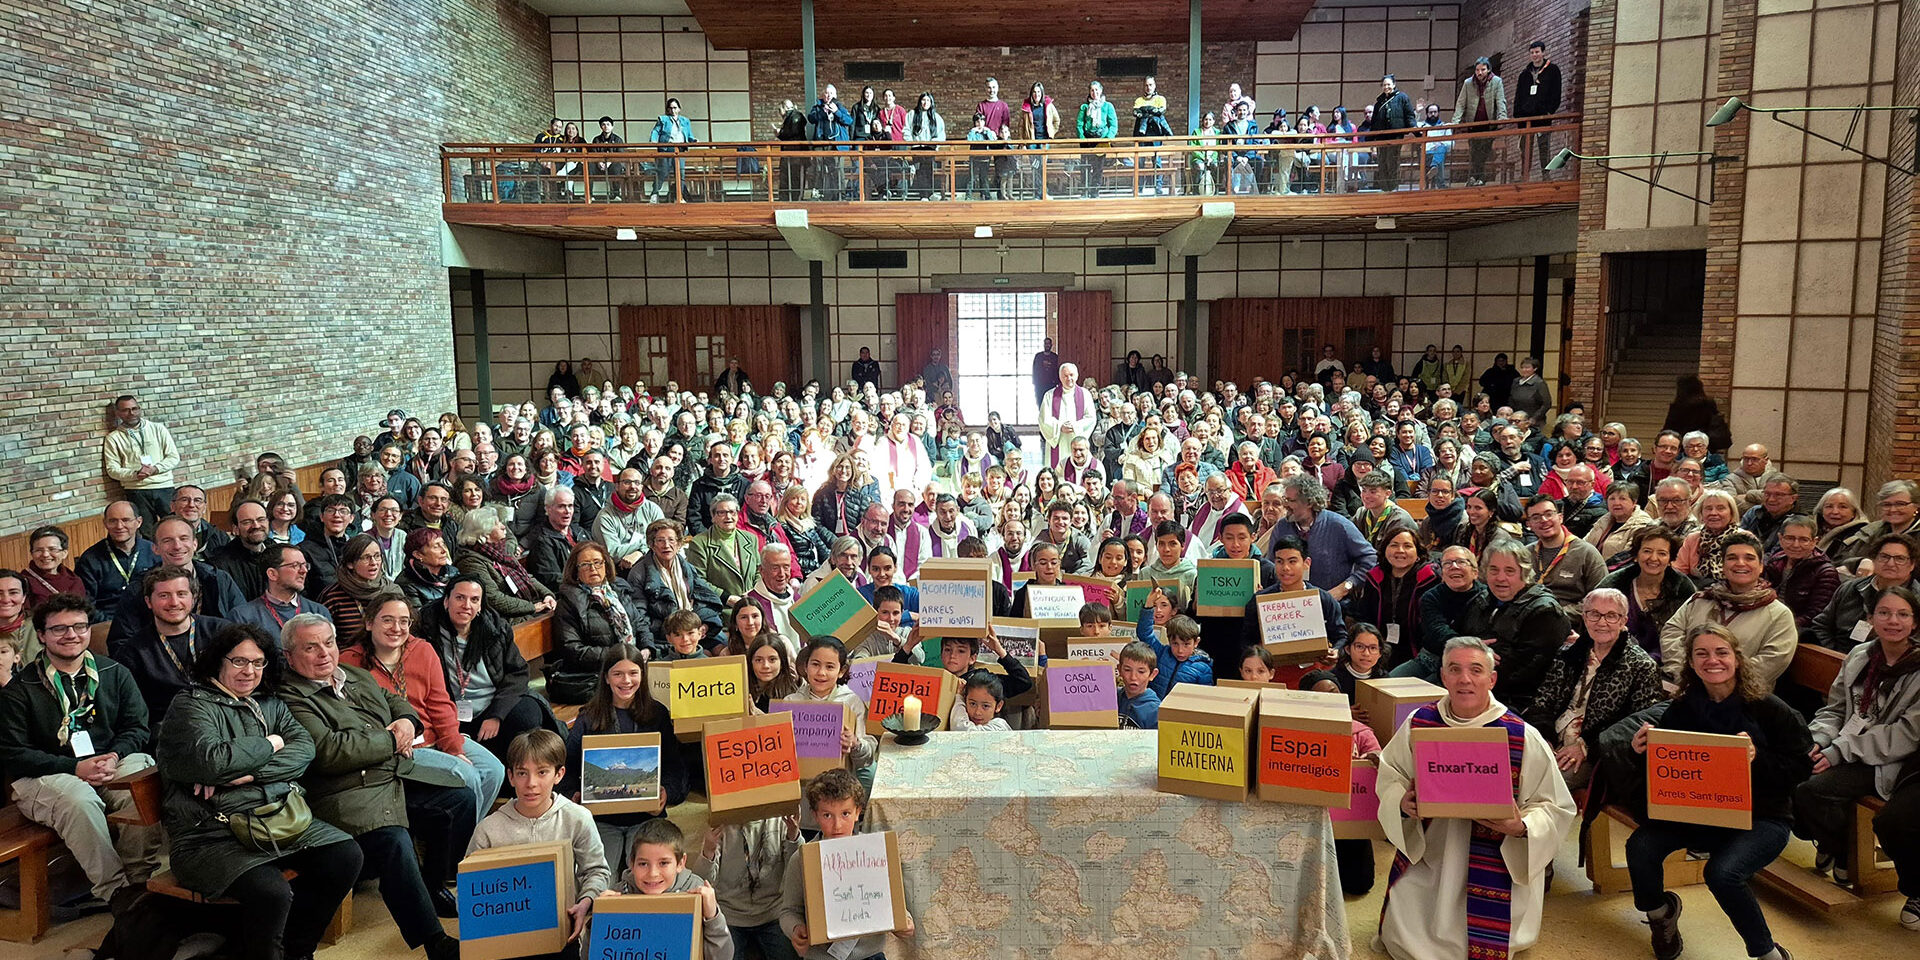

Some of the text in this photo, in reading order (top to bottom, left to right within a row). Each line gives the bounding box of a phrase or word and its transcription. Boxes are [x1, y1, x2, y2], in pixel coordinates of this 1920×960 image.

[1211, 576, 1241, 587] TSKV
[806, 588, 845, 621] Cristianisme
[922, 606, 954, 614] ARRELS
[1262, 598, 1313, 612] TREBALL DE
[921, 615, 974, 626] SANT IGNASI
[1265, 610, 1304, 623] CARRER
[1111, 628, 1135, 639] CENTR
[1266, 623, 1297, 632] ARRELS
[1267, 629, 1314, 641] SANT IGNASI
[1070, 649, 1104, 657] ARRELS
[849, 669, 876, 680] Eco-m
[1064, 673, 1096, 682] CASAL
[653, 681, 671, 689] Hos
[678, 680, 736, 699] Marta
[878, 676, 931, 697] Esplai
[1064, 684, 1100, 694] LOIOLA
[793, 726, 836, 738] ompanyi
[717, 731, 782, 759] Esplai
[1181, 730, 1223, 750] AYUDA
[1270, 735, 1328, 758] Espai
[1655, 746, 1710, 762] Centre
[1170, 750, 1234, 773] FRATERNA
[1268, 758, 1340, 777] interreligiós
[1427, 761, 1499, 775] EnxarTxad
[720, 760, 792, 783] la Plaça
[1656, 765, 1703, 780] Obert
[1657, 788, 1743, 803] Arrels Sant Ignasi
[471, 875, 532, 896] Lluís M.
[832, 885, 854, 902] Sant
[472, 897, 531, 917] Chanut
[604, 924, 641, 940] Joan
[602, 947, 649, 960] Suñol
